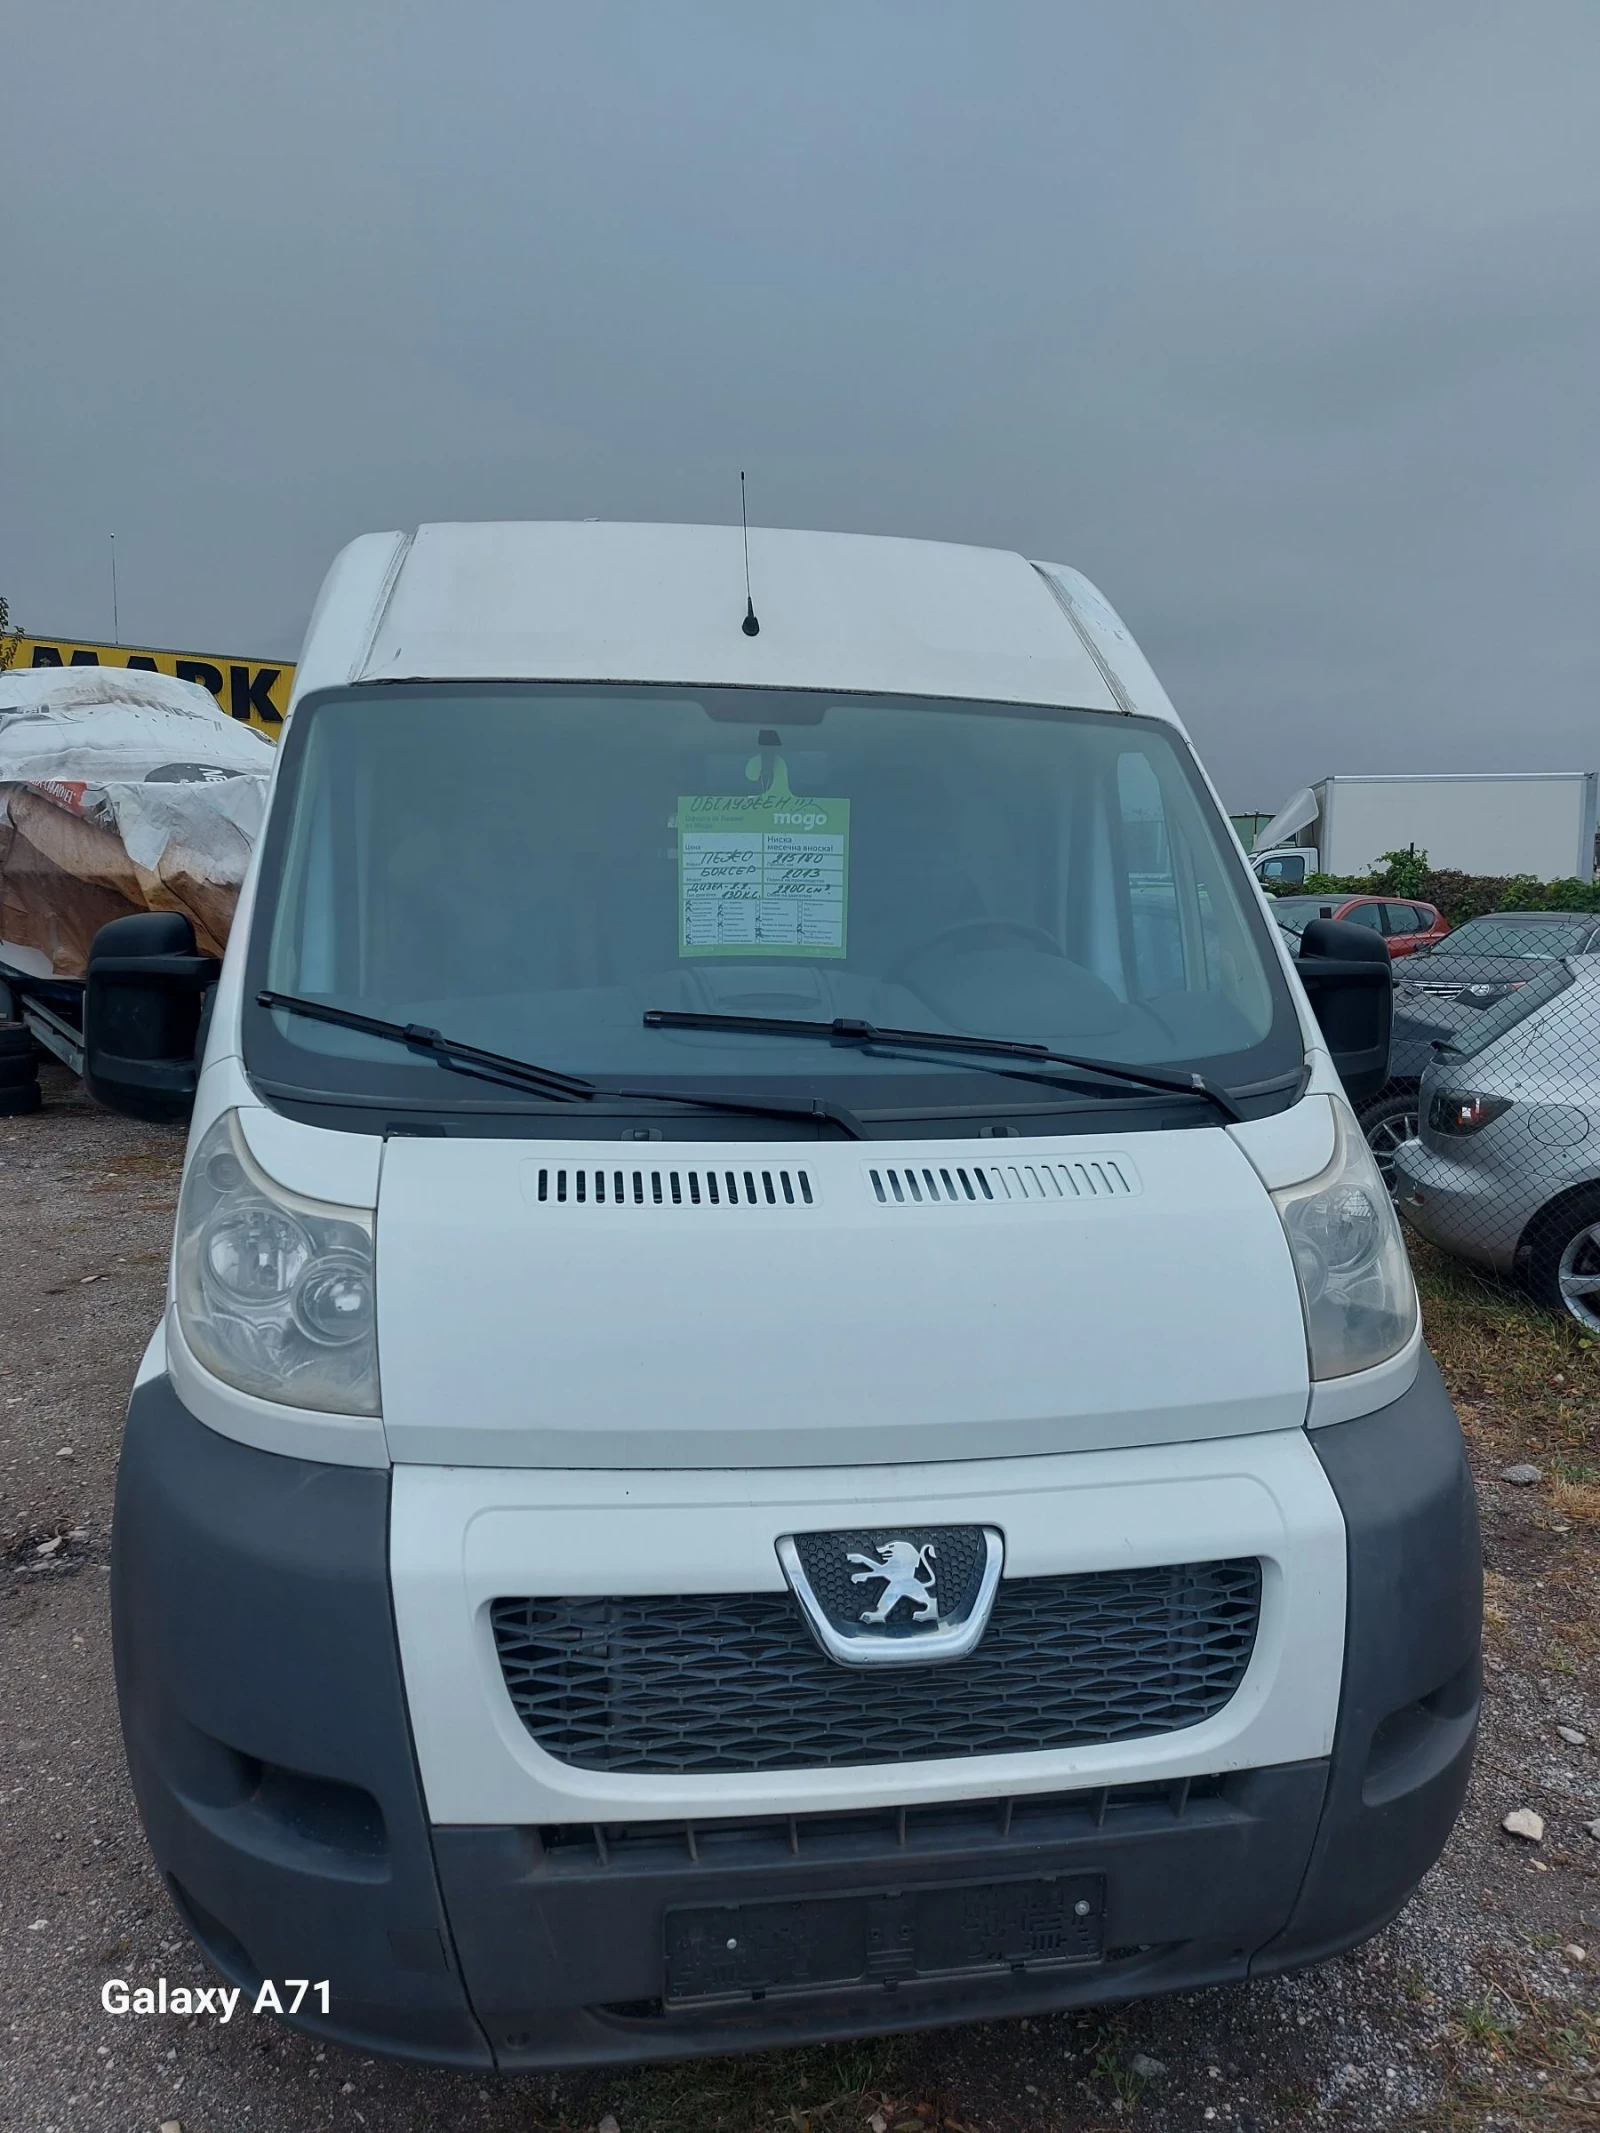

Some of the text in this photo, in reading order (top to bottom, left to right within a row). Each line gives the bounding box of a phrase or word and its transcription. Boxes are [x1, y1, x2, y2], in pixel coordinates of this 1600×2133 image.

[773, 813, 827, 831] mogo
[767, 835, 792, 843] Ниска
[701, 849, 754, 865] ПЕЖО
[700, 865, 756, 876] БОКСЕР
[781, 868, 821, 880] 2013
